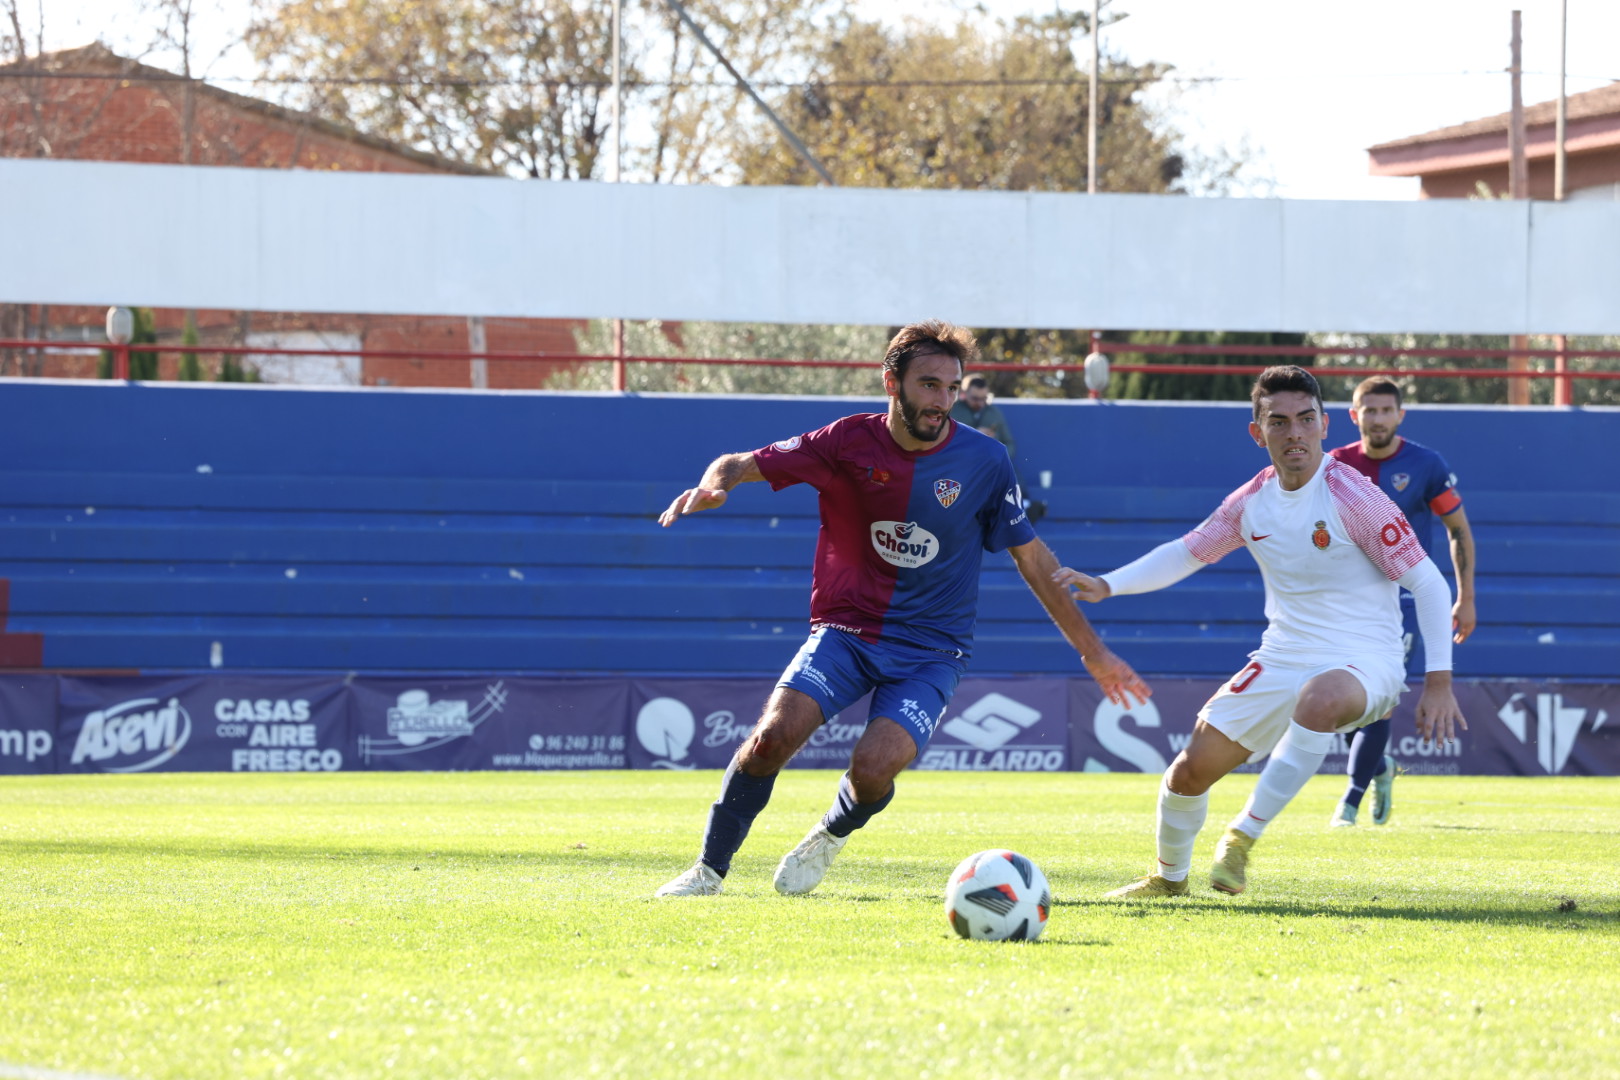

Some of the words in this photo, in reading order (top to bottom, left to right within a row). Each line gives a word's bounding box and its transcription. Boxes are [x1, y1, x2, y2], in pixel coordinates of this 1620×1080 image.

[875, 529, 932, 558] Choví
[214, 699, 310, 722] CASAS
[898, 707, 926, 735] Alzira
[70, 697, 180, 765] Asevi
[216, 724, 247, 738] CON
[249, 724, 316, 746] AIRE
[232, 749, 342, 772] FRESCO
[917, 750, 1063, 771] GALLARDO
